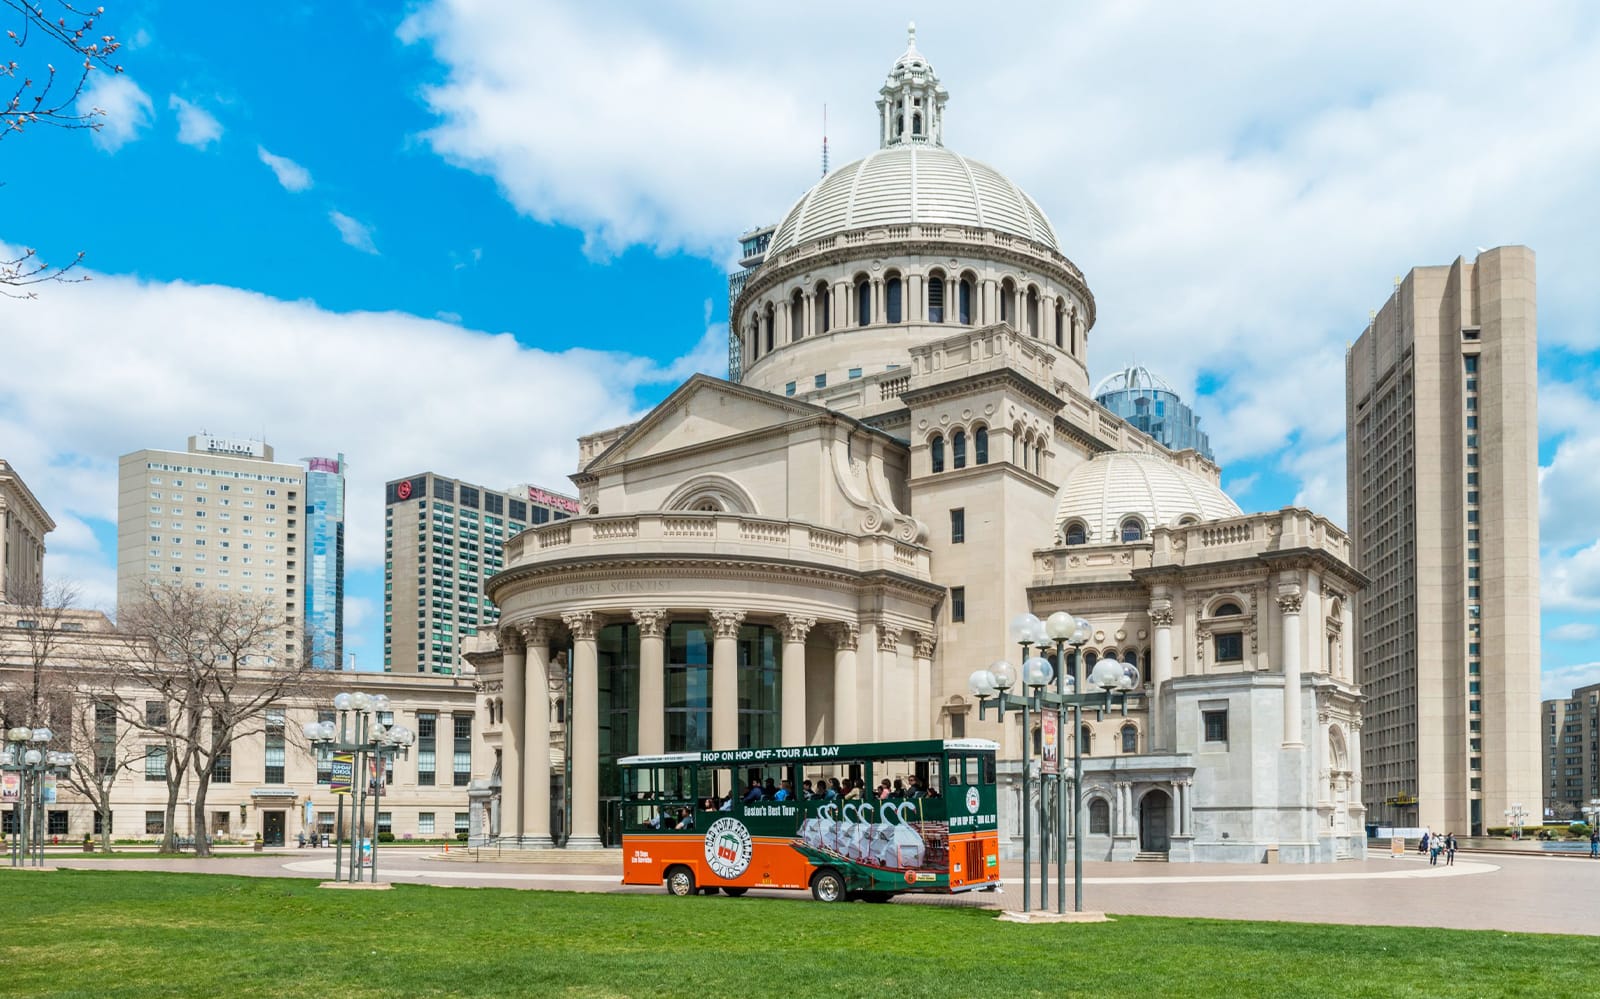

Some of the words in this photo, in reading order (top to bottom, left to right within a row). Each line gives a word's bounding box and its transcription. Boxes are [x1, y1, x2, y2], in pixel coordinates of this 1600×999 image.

[703, 752, 720, 762] HOP
[721, 752, 734, 761] ON
[735, 751, 754, 760] HOP
[802, 747, 819, 757] ALL
[821, 746, 840, 756] DAY
[768, 805, 781, 816] Best
[782, 804, 796, 816] Tour
[705, 830, 716, 848] OLD
[713, 819, 735, 833] TOWN
[735, 822, 752, 864] TROLLEY
[708, 853, 741, 879] TOURS
